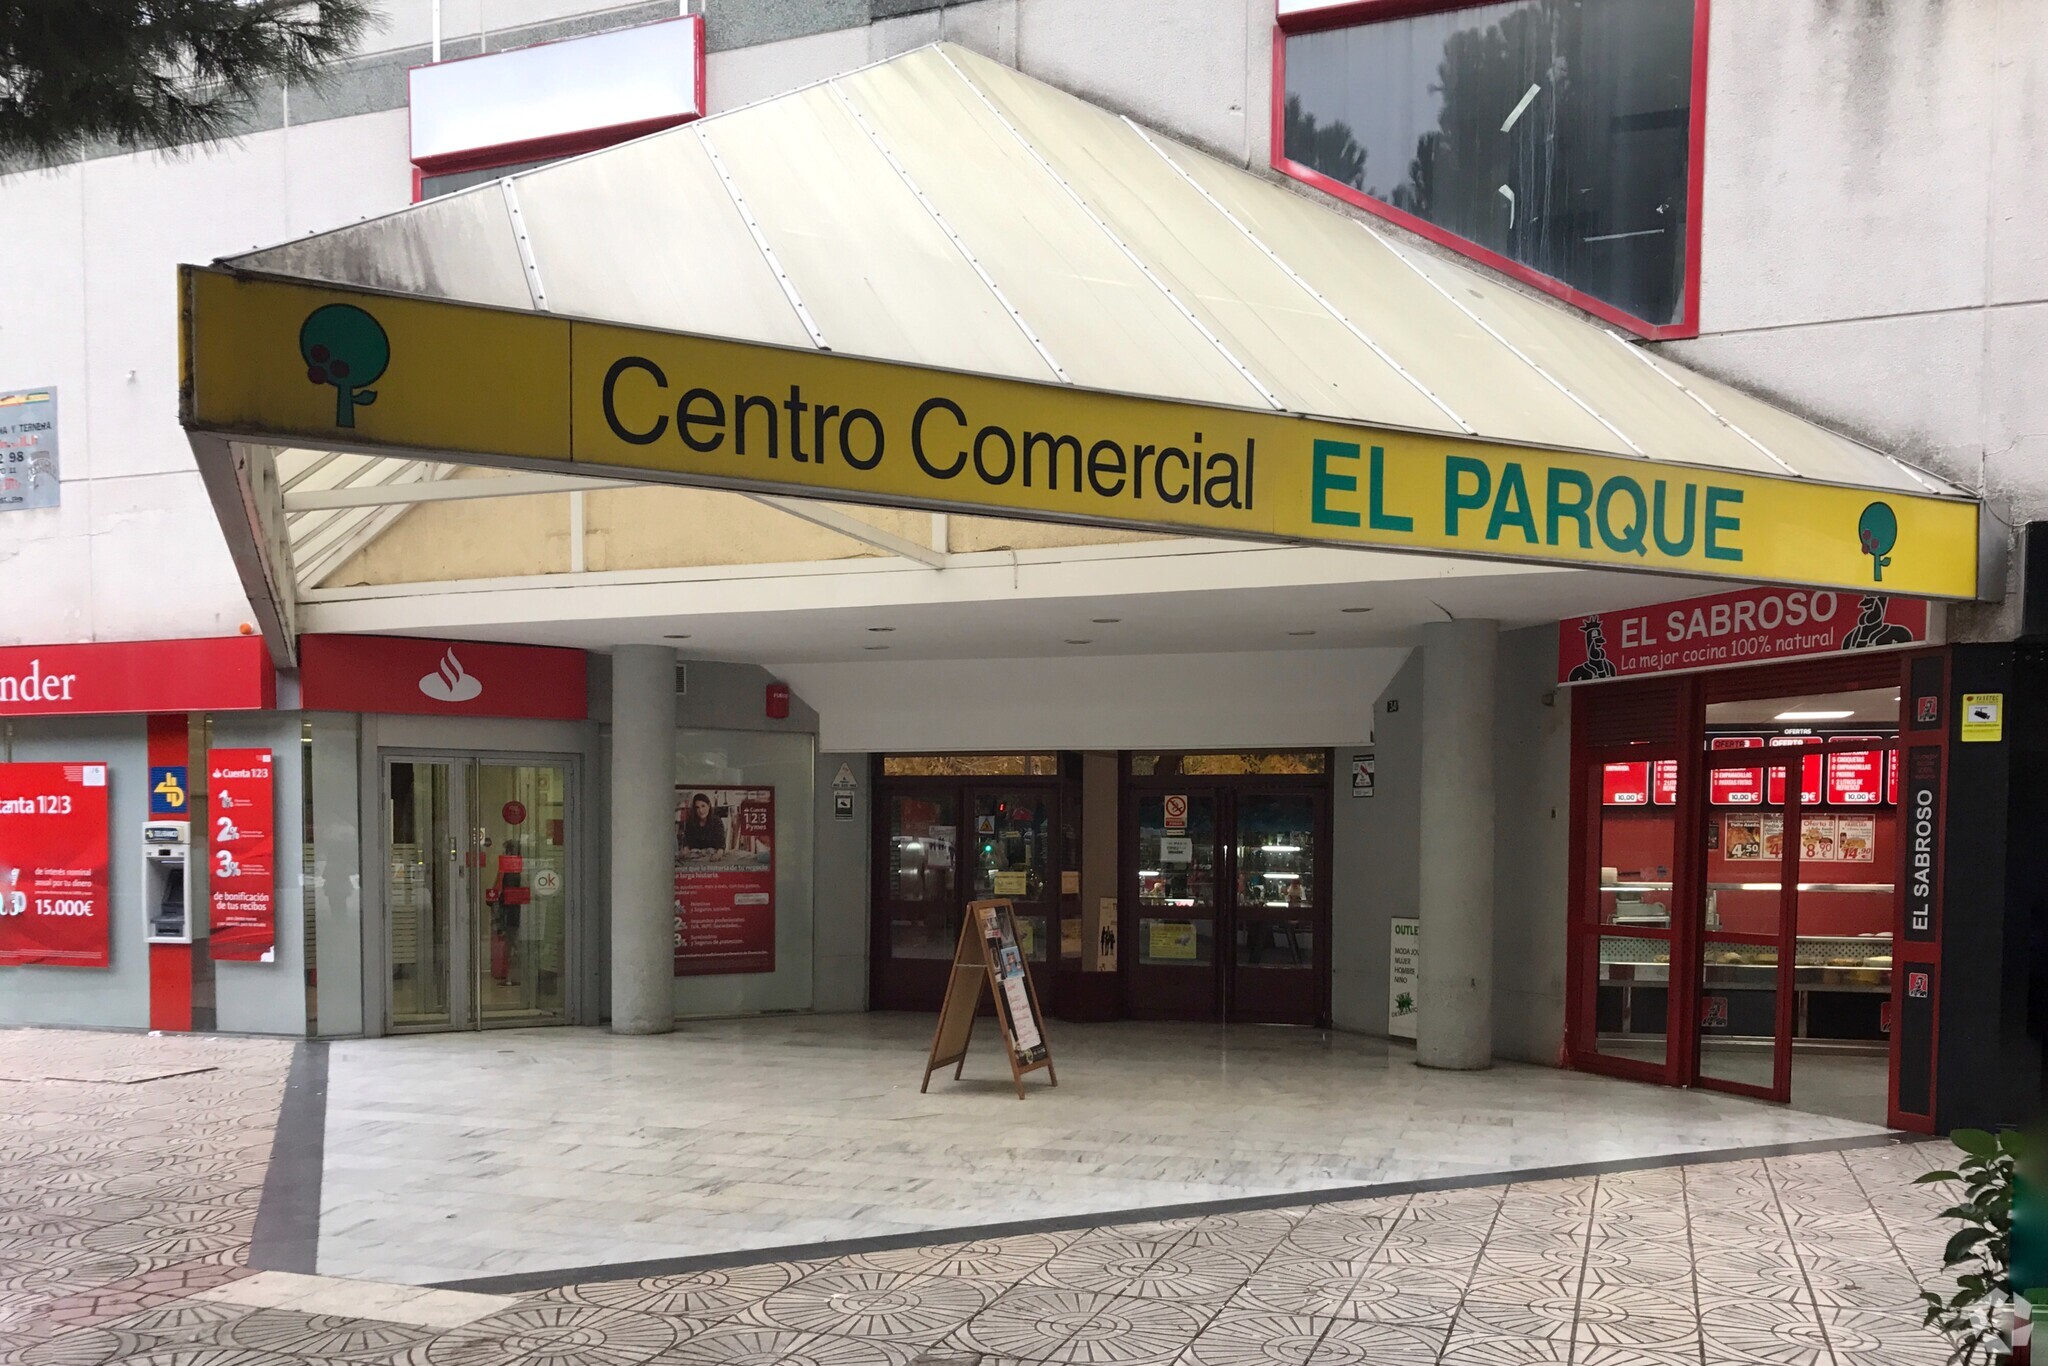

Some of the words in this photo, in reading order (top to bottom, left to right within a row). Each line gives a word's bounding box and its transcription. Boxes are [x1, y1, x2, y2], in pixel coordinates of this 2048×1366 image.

[9, 452, 24, 462] 98
[603, 356, 885, 470] Centro
[912, 398, 1255, 510] Comercial
[1312, 439, 1413, 532] EL
[1446, 455, 1744, 562] PARQUE
[1622, 617, 1657, 649] EL
[1666, 591, 1838, 642] SABROSO
[1621, 655, 1636, 671] La
[1640, 650, 1679, 671] mejor
[1683, 644, 1727, 663] cocina
[1731, 635, 1772, 656] 100%
[1776, 627, 1834, 652] natural
[0, 659, 76, 702] nder
[223, 768, 251, 778] Cuenta
[1914, 790, 1933, 897] SABROSO
[35, 899, 94, 917] 15.000€
[1913, 904, 1929, 930] EL
[1395, 957, 1411, 965] MUJER
[1395, 966, 1415, 975] HOMBRE
